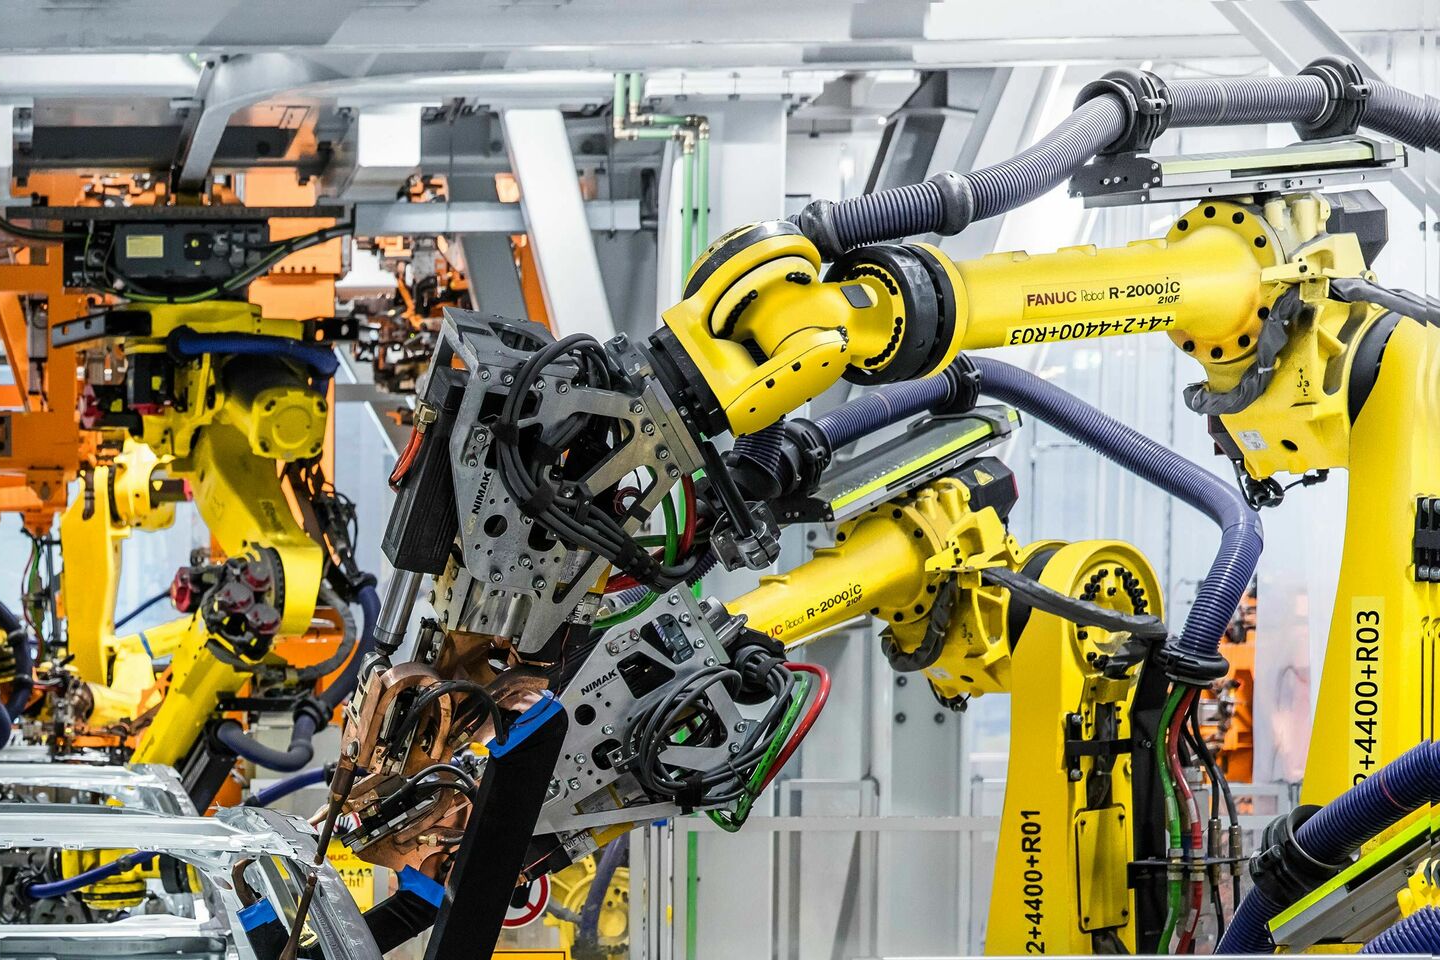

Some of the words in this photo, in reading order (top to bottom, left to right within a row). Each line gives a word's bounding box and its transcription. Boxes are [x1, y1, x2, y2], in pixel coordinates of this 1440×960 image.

[1026, 291, 1077, 307] FANUC
[1080, 289, 1105, 302] Robot
[1109, 277, 1181, 299] R-2000iC
[1157, 294, 1180, 304] 210F
[1010, 315, 1174, 345] +4+2+4400+R03
[472, 471, 491, 514] NIMAK
[581, 669, 618, 696] NIMAK
